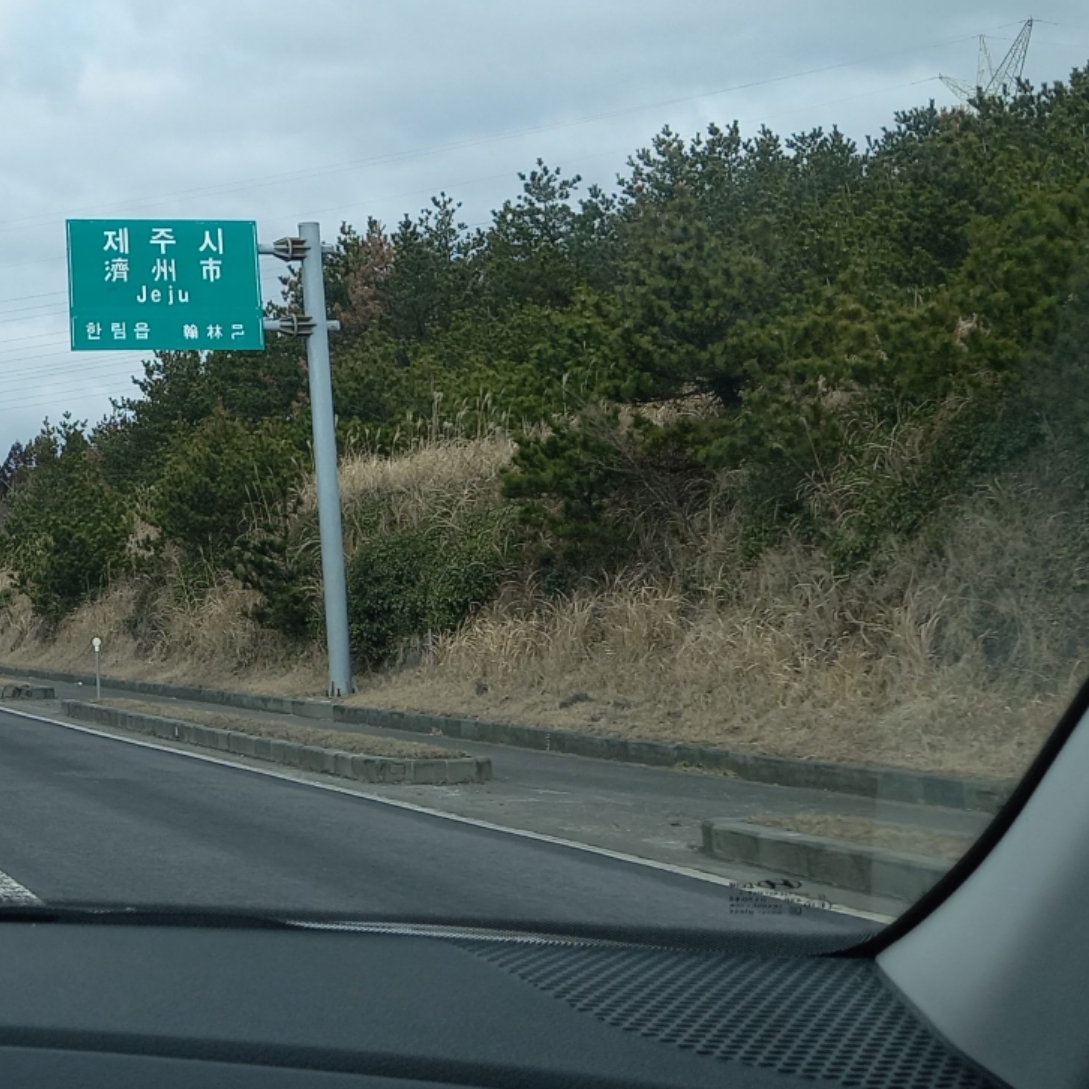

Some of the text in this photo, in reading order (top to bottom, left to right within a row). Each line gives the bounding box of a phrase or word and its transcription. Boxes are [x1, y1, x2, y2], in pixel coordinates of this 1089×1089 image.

[103, 227, 223, 255] 제주시
[136, 285, 189, 305] Jeju
[86, 321, 150, 340] 한림읍
